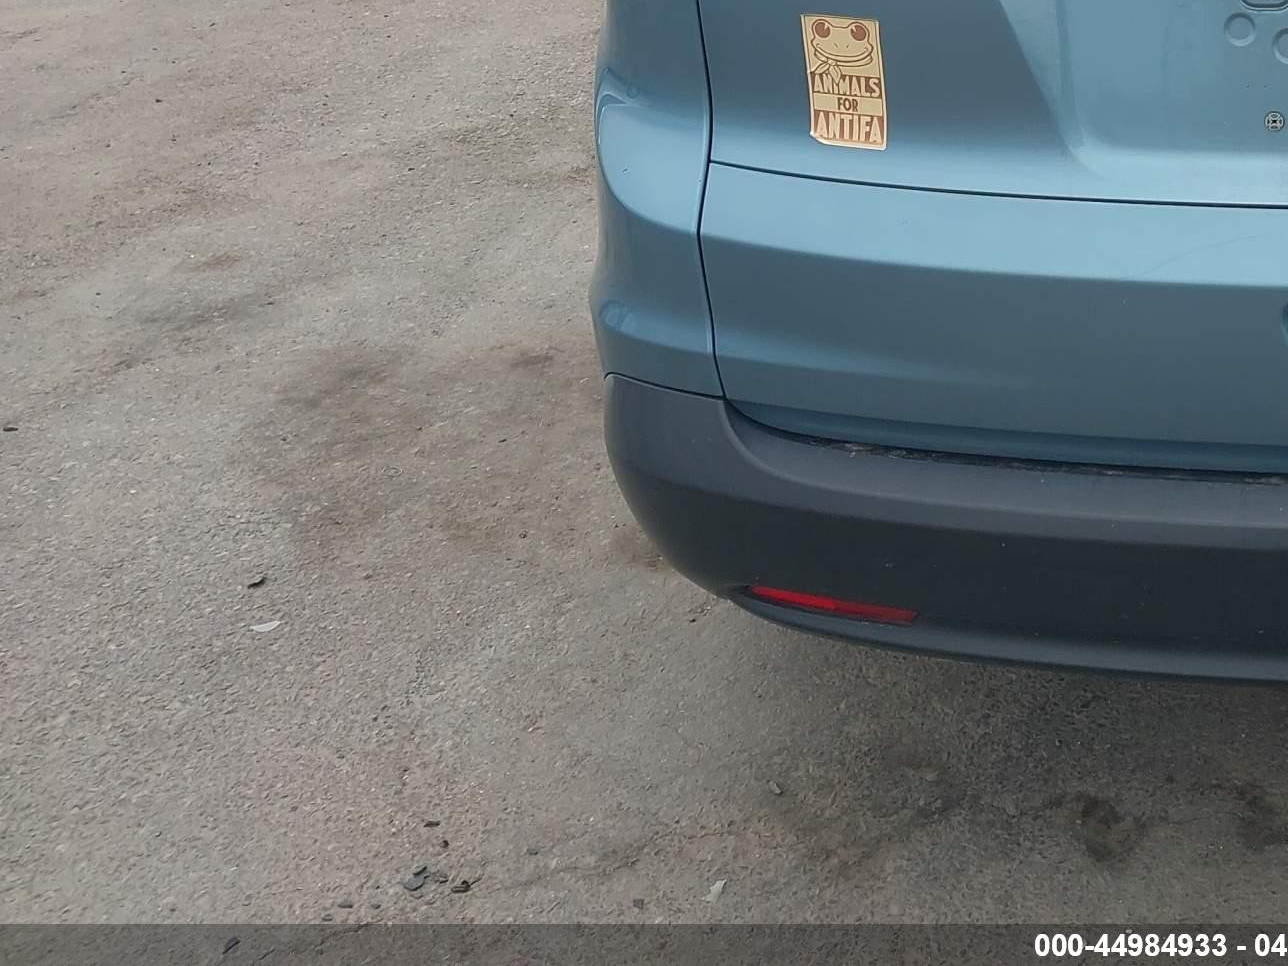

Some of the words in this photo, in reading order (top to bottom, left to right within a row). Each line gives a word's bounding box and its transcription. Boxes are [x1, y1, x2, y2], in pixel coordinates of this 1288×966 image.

[814, 74, 881, 98] ANIMALS
[837, 97, 858, 112] FOR
[816, 112, 882, 143] ANTIFA
